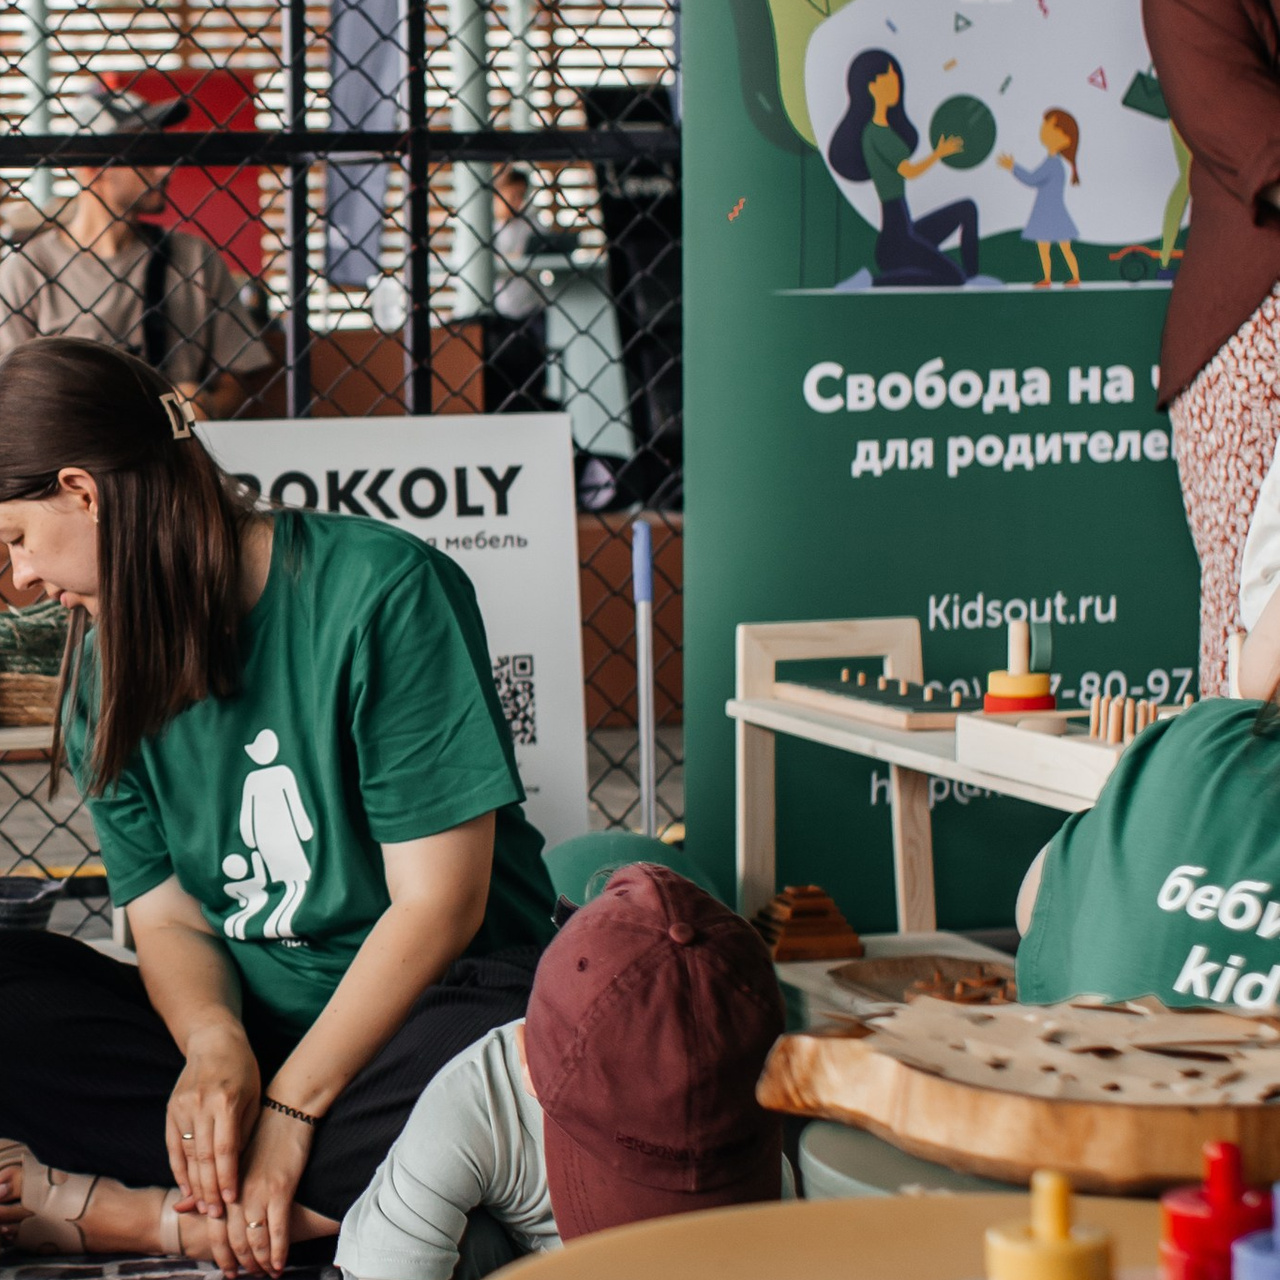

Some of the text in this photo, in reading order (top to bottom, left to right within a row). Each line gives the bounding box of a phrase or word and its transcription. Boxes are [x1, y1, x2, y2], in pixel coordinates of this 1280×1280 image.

[803, 357, 1051, 414] Свобода
[1069, 364, 1135, 405] на
[851, 428, 1177, 478] для родителе
[445, 528, 528, 550] мебель
[928, 591, 1117, 630] Kidsout.ru
